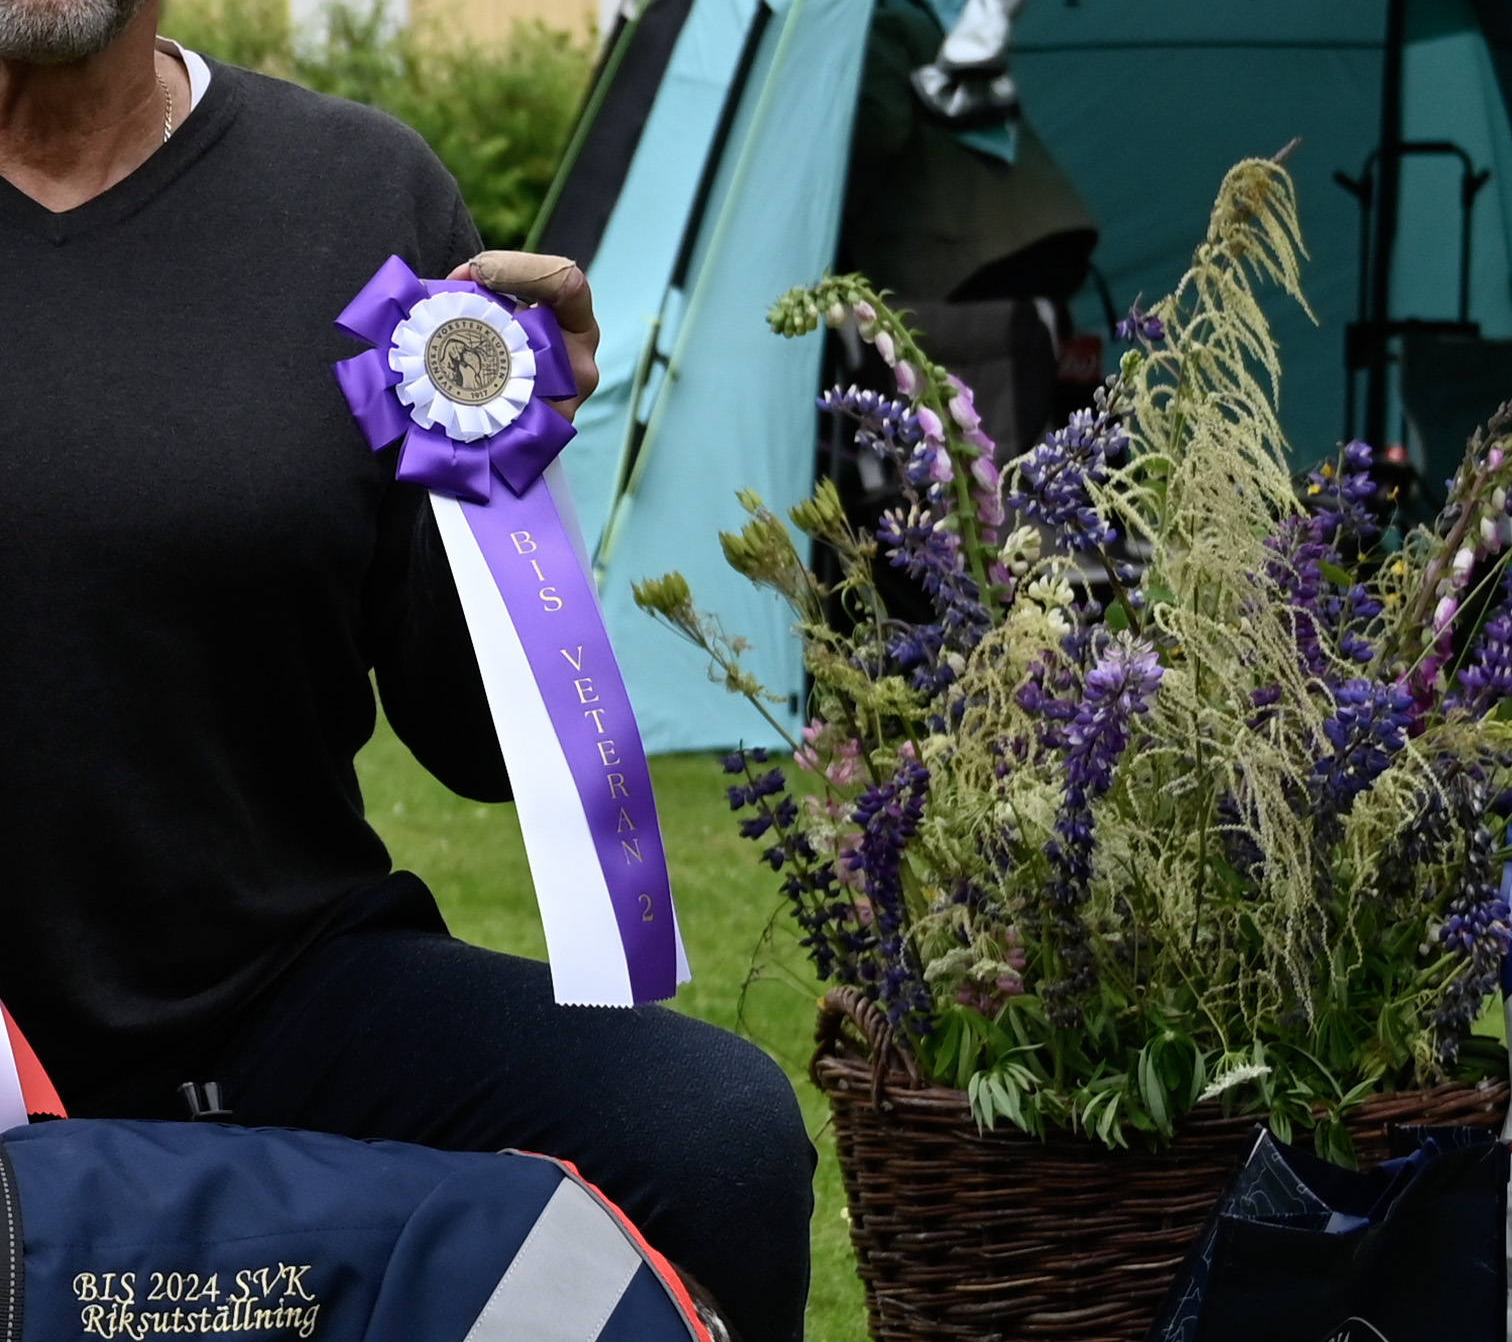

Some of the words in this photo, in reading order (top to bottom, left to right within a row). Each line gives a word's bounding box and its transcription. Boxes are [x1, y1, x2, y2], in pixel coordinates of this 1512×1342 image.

[510, 530, 564, 612] BIS
[560, 646, 644, 866] VETERAN
[638, 894, 654, 922] 2
[73, 1271, 136, 1305] BIS
[147, 1271, 220, 1303] 2024
[226, 1262, 316, 1303] SVK
[81, 1296, 321, 1342] Riksutställning
